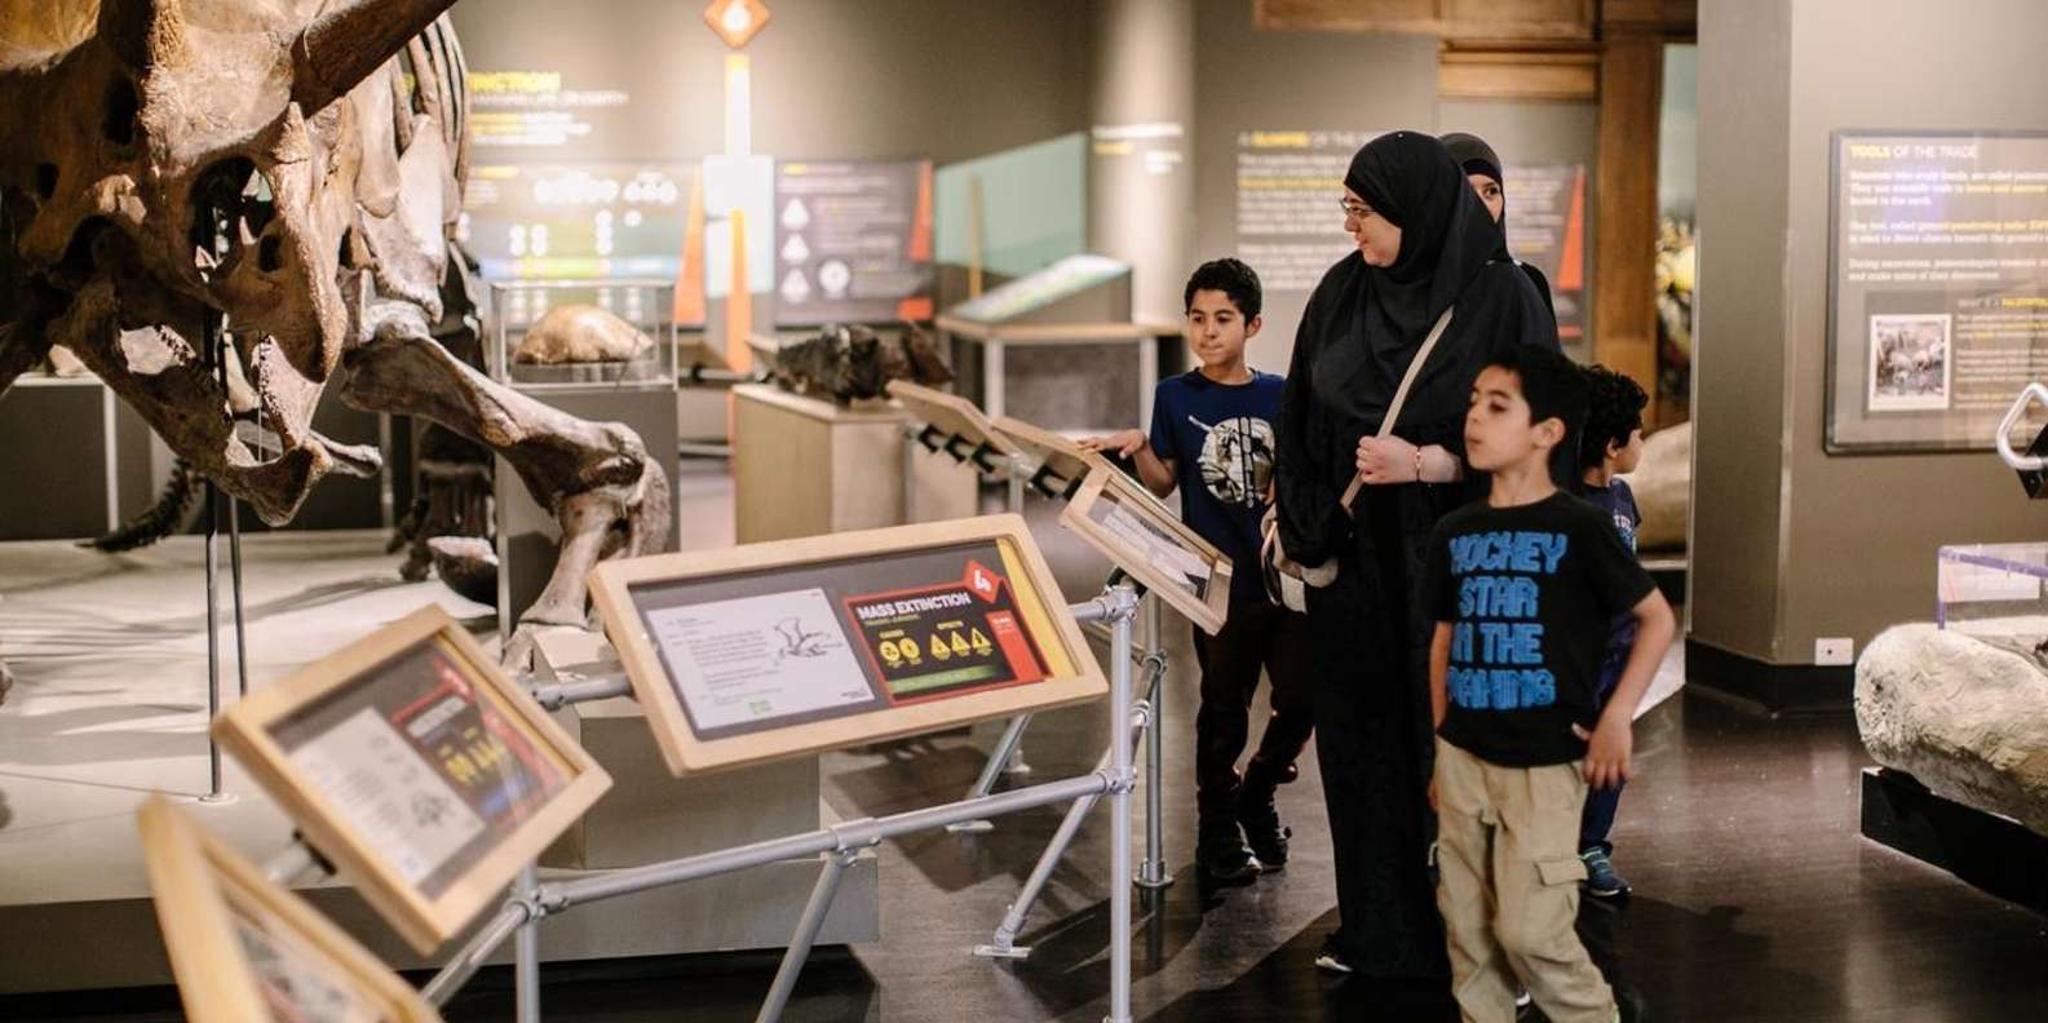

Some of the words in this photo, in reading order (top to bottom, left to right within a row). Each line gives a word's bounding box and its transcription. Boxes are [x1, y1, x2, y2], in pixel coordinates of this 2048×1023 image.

[1449, 531, 1568, 575] HOCKEY
[974, 568, 992, 593] 4
[1458, 576, 1539, 617] STAR
[856, 602, 896, 620] MASS
[894, 591, 973, 615] EXTINCTION
[1479, 622, 1544, 663] THE
